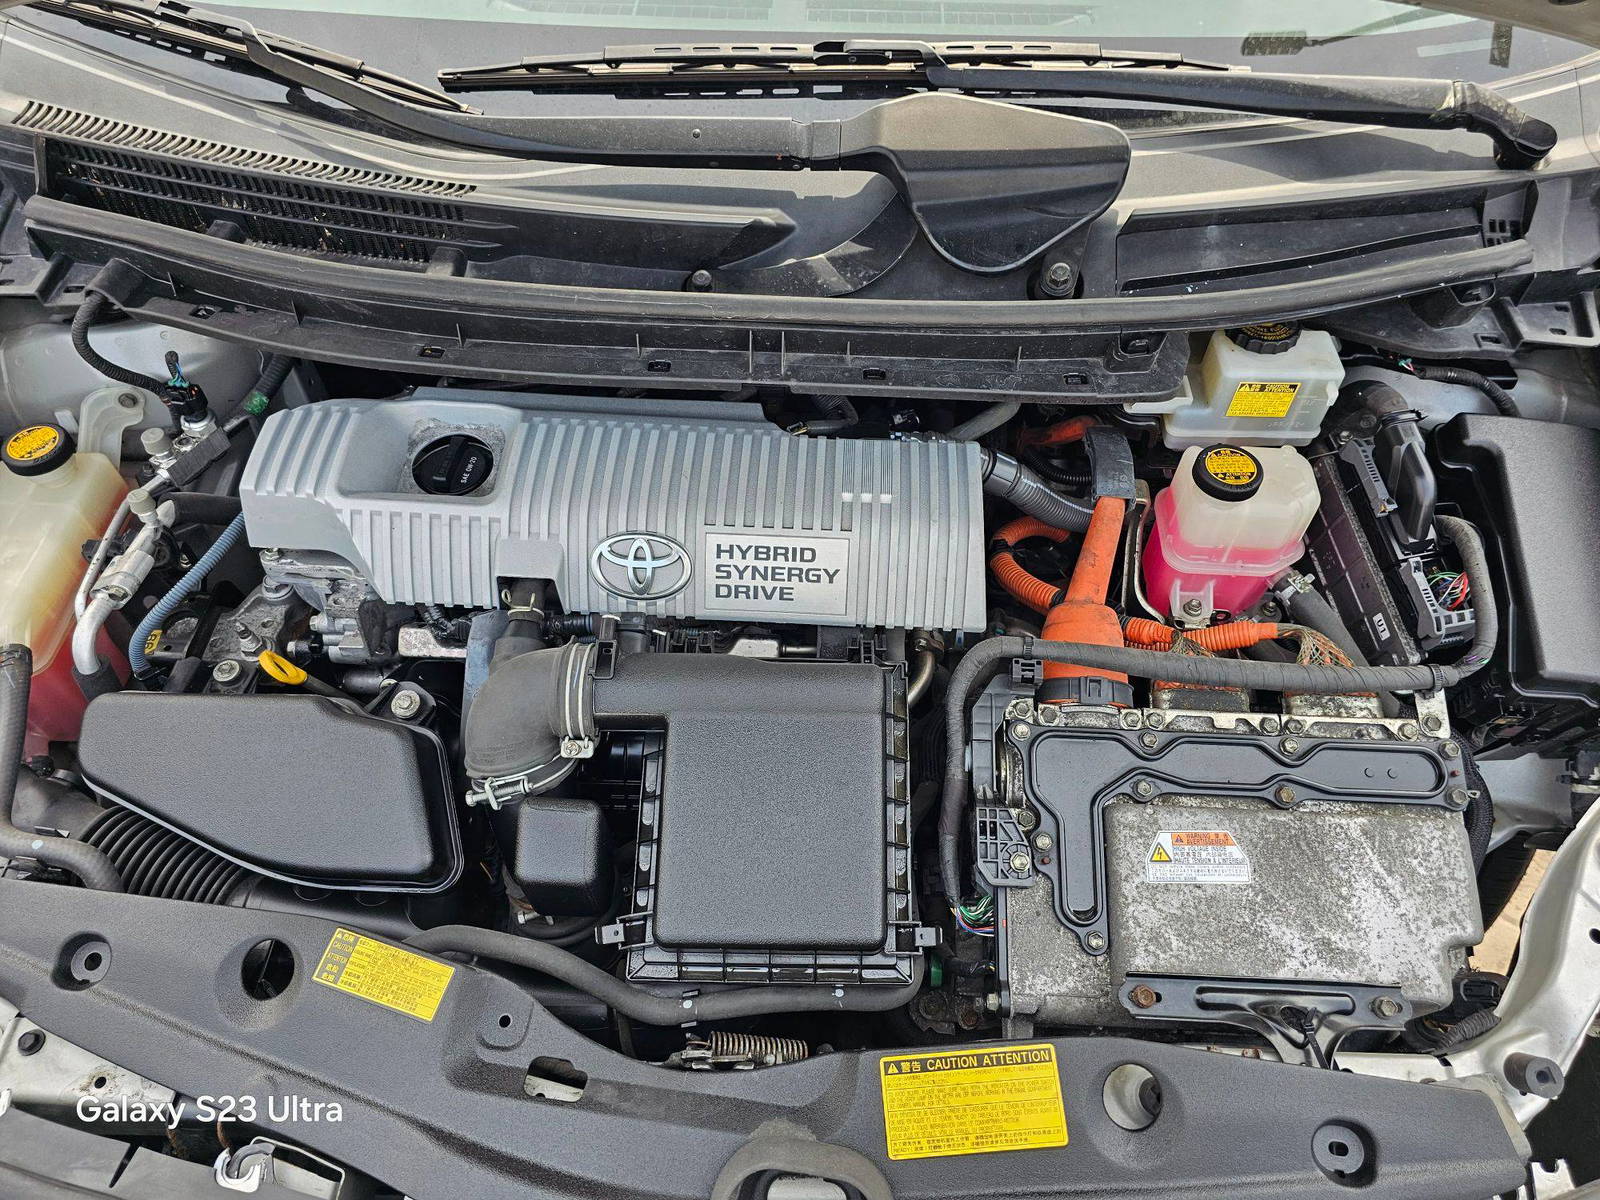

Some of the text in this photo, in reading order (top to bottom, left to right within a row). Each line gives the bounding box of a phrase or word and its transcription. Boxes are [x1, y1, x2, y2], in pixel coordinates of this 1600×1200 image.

[460, 473, 470, 484] SAE
[716, 543, 817, 563] HYBRID
[715, 564, 841, 584] SYNERGY
[715, 584, 794, 601] DRIVE
[926, 1055, 978, 1071] CAUTION
[983, 1049, 1050, 1066] ATTENTION
